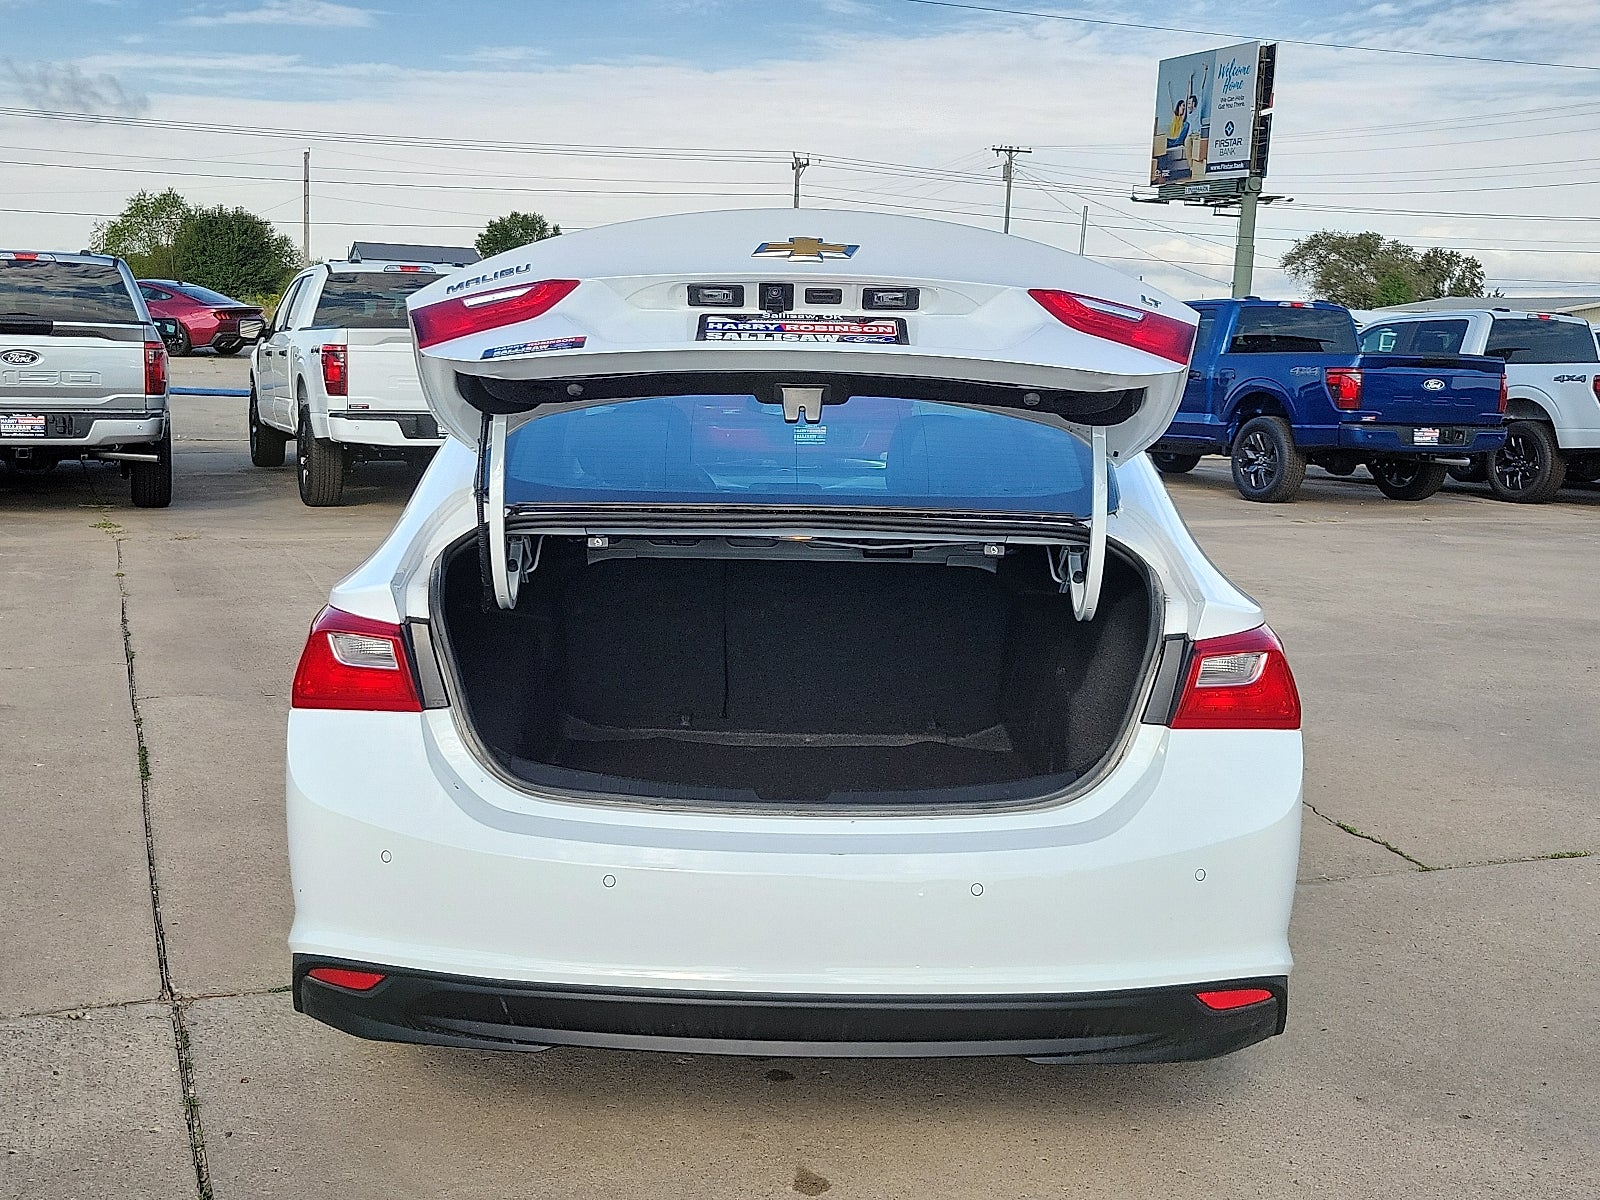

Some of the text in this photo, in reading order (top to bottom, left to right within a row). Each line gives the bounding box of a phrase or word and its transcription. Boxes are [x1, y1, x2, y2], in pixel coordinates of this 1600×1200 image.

[1218, 57, 1250, 79] Welcome
[1223, 78, 1243, 94] Home
[1215, 138, 1243, 148] FIRSTAR
[1220, 148, 1236, 156] BANK
[446, 263, 532, 295] MALIBU
[1140, 294, 1162, 309] LT
[761, 312, 819, 321] Sallisaw,
[707, 322, 893, 333] HARRY ROBINSON
[705, 332, 839, 343] SALLISAW
[7, 352, 32, 363] Ford
